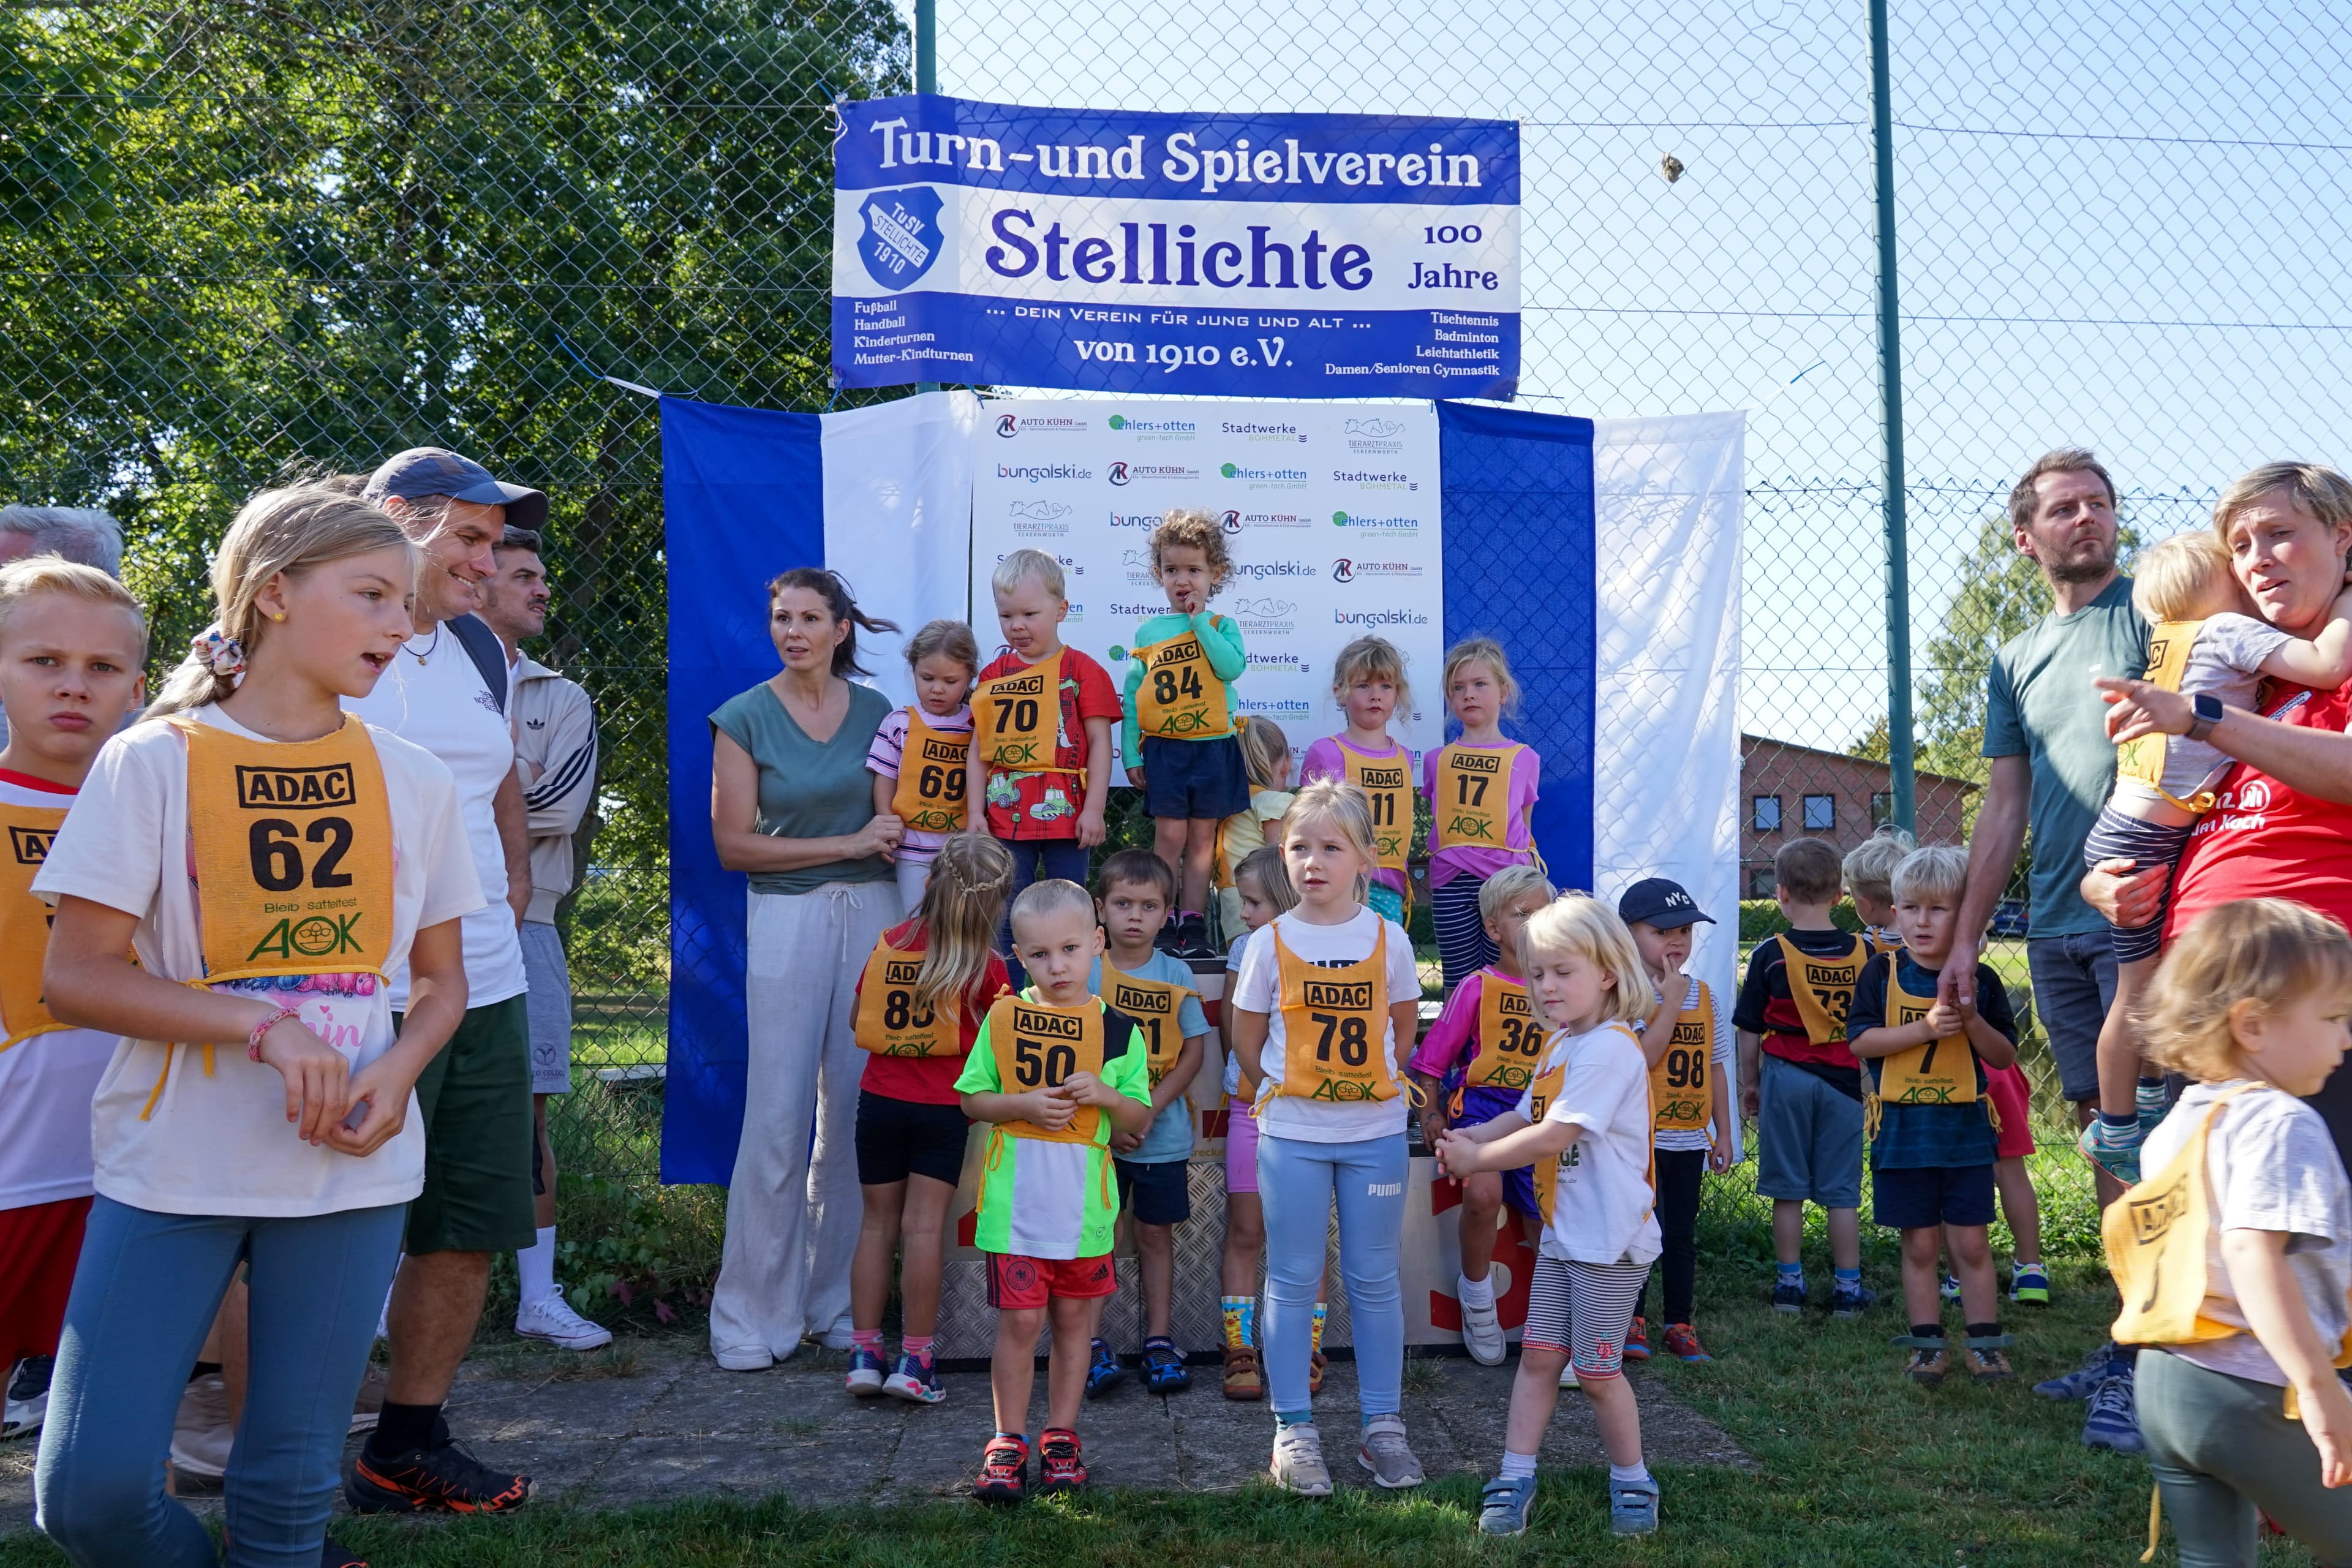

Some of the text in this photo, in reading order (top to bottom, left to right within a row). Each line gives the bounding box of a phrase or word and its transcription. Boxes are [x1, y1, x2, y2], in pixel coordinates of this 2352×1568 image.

[870, 116, 1482, 192] Turn-und Spielverein
[891, 202, 925, 236] TuSV
[873, 214, 926, 265] STELLICHTE
[1425, 225, 1482, 244] 100
[873, 242, 907, 275] 1910
[985, 208, 1373, 290] Stellichte
[1408, 262, 1499, 290] Jahre
[854, 316, 906, 331] Handball
[1015, 306, 1061, 320] DEIN
[1069, 308, 1142, 324] VEREIN
[1152, 311, 1188, 325] FÜR
[1197, 314, 1250, 327] JUNG
[1259, 317, 1300, 328] UND
[1308, 317, 1344, 329] ALT
[1431, 311, 1499, 327] Tischtennis
[854, 331, 936, 349] Kinderturnen
[1434, 329, 1499, 344] Badminton
[854, 349, 973, 366] Mutter-Kindturnen
[1074, 336, 1293, 373] von 1910 e.V.
[1415, 345, 1499, 360] Leichtathletik
[1325, 362, 1500, 377] Damen/Senioren Gymnastik
[1047, 417, 1072, 426] KÜHN
[1118, 420, 1196, 431] ehlers+otten
[1222, 422, 1296, 434] Stadtwerke
[997, 463, 1092, 483] bungalski.de
[1159, 465, 1185, 473] KÜHN
[1230, 467, 1307, 479] ehlers+otten
[1333, 471, 1407, 482] Stadtwerke
[1013, 522, 1069, 531] TIERARZTPRAXIS
[1271, 513, 1297, 522] KÜHN
[1341, 516, 1418, 527] ehlers+otten
[1235, 560, 1316, 580] ungalski.de
[1382, 562, 1408, 570] KÜHN
[1110, 603, 1171, 614] Stadtwer
[1335, 608, 1428, 629] bungalski.de
[1153, 645, 1194, 665] ADAC
[1246, 652, 1298, 664] dtwerke
[995, 679, 1039, 692] ADAC
[1154, 666, 1203, 705] 84
[1238, 699, 1309, 710] hlers+otten
[994, 699, 1038, 733] 70
[1158, 708, 1210, 734] AOK
[993, 743, 1039, 764] AOK
[1455, 756, 1495, 769] ADAC
[249, 771, 345, 802] ADAC
[919, 765, 967, 801] 69
[1366, 772, 1401, 785] ADAC
[1458, 774, 1489, 807] 17
[1371, 793, 1394, 826] 11
[908, 810, 964, 831] AOK
[1447, 815, 1494, 840] AOK
[2218, 813, 2266, 831] Koch
[248, 816, 353, 892] 62
[1374, 837, 1402, 856] OK
[265, 897, 357, 913] Bleib sattelfest
[1665, 891, 1691, 907] NYC
[246, 912, 363, 961] AOK
[890, 965, 921, 981] AD
[1811, 968, 1852, 983] ADAC
[1120, 990, 1167, 1009] ADAC
[1311, 986, 1367, 1006] ADAC
[1504, 997, 1532, 1012] AD
[1812, 989, 1852, 1022] 73
[1019, 1013, 1076, 1036] ADAC
[1672, 1026, 1703, 1041] ADAC
[1311, 1012, 1368, 1066] 78
[1499, 1018, 1544, 1057] 36
[1016, 1038, 1076, 1088] 50
[1314, 1065, 1335, 1076] Bleib
[1667, 1049, 1704, 1088] 98
[1311, 1077, 1384, 1102] AOK
[1898, 1086, 1958, 1104] AOK
[1656, 1101, 1706, 1121] AOK
[1368, 1182, 1401, 1196] PUMA
